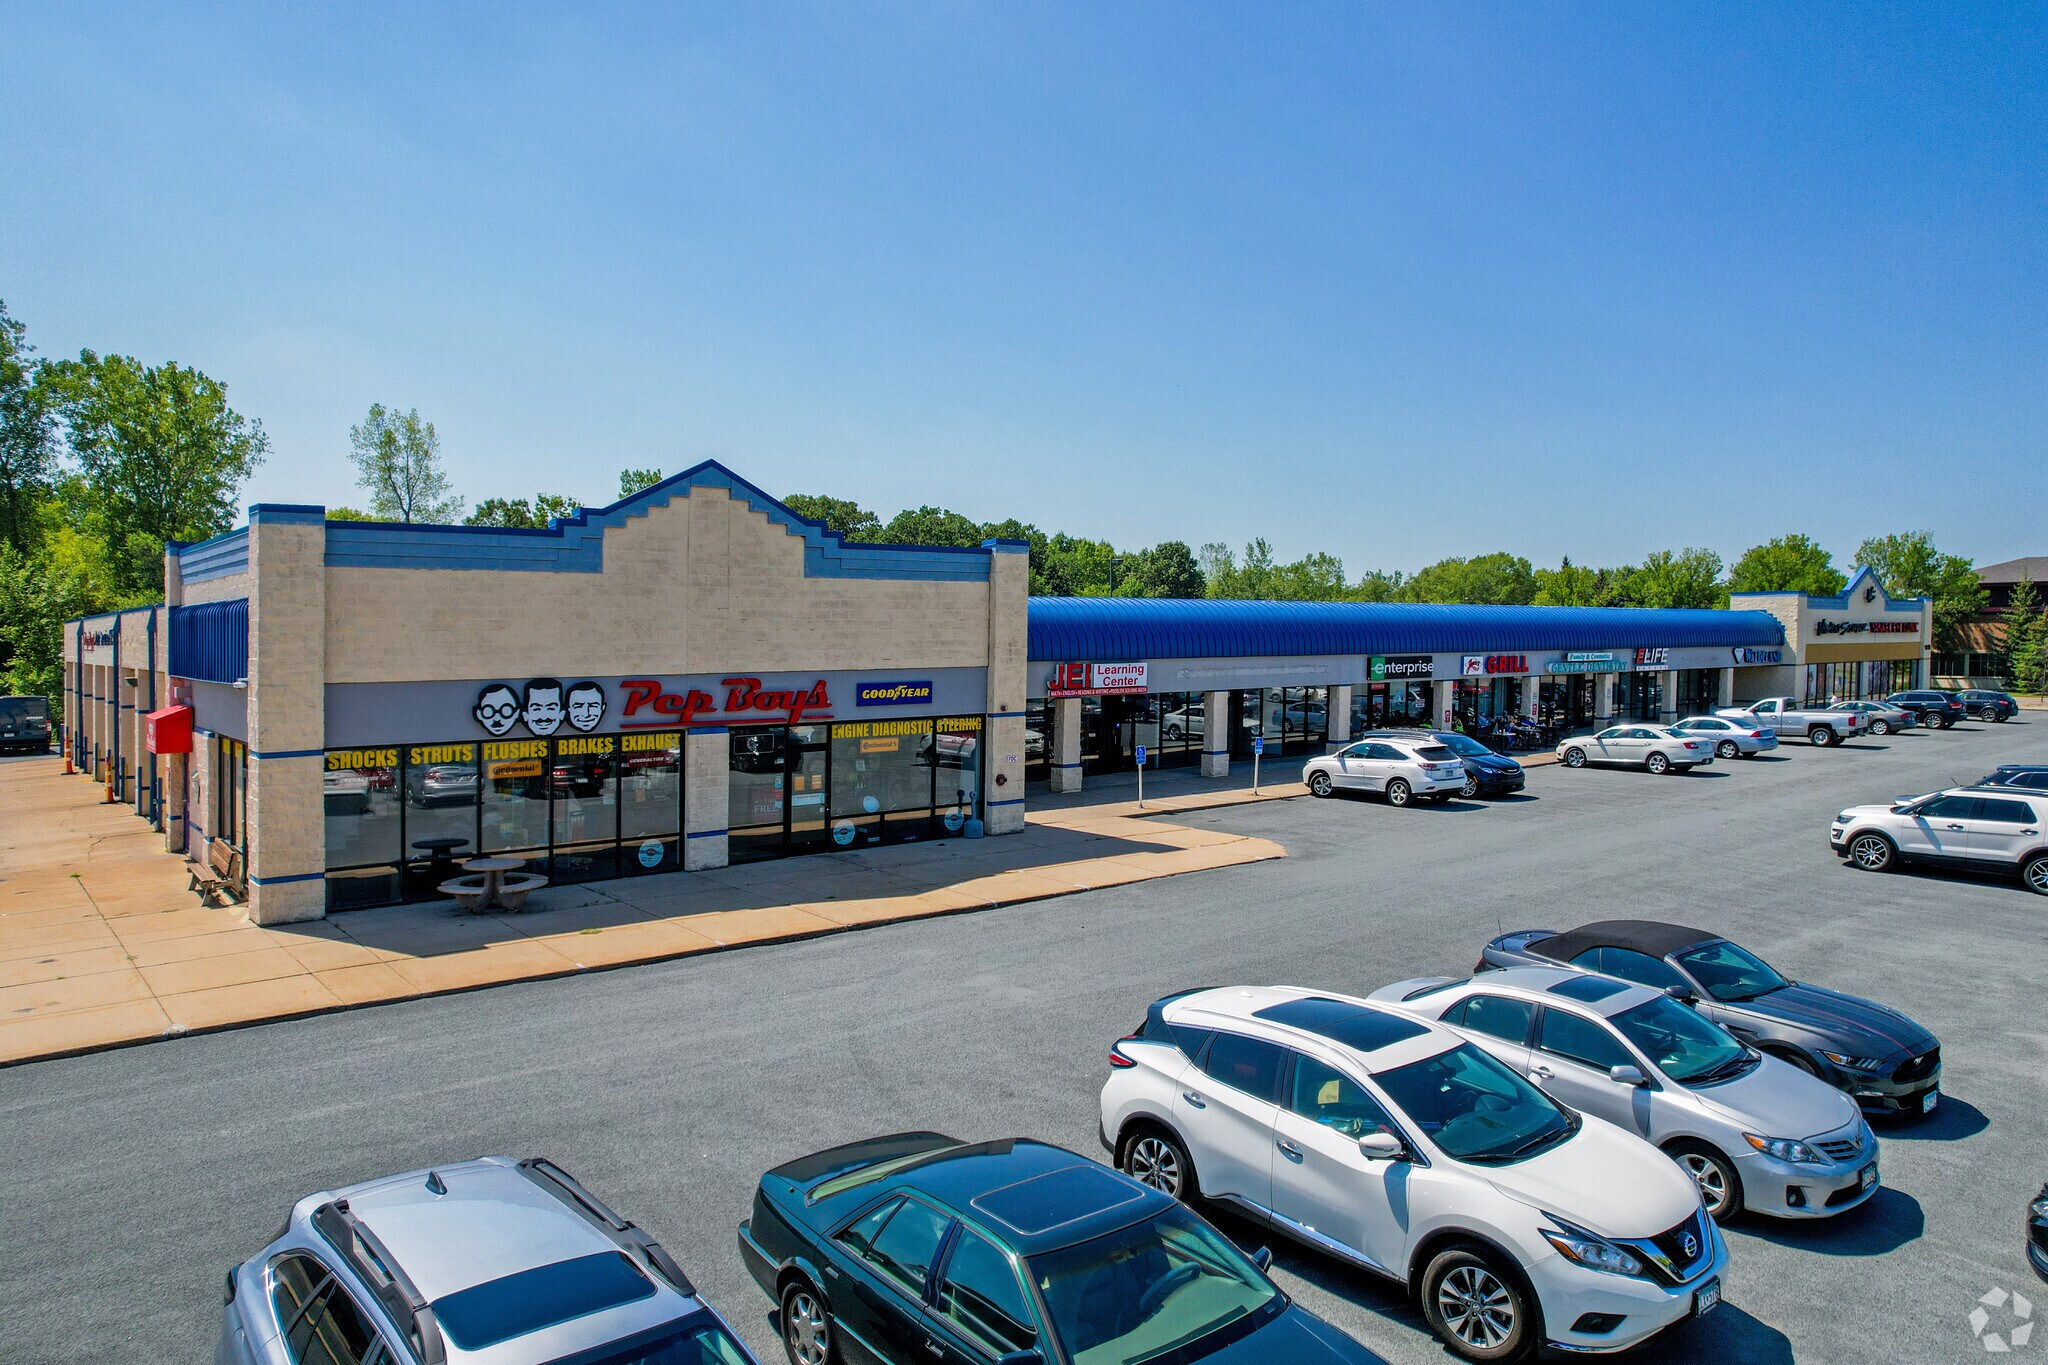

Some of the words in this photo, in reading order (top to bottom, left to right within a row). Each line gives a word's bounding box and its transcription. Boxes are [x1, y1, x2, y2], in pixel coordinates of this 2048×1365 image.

[1097, 664, 1144, 676] Learning
[1373, 660, 1434, 675] enterprise
[1487, 655, 1529, 674] GRILL
[1551, 662, 1584, 673] GENTLE
[1587, 661, 1628, 672] DENTISTRY
[1049, 663, 1091, 689] JEI
[1103, 676, 1138, 686] Center
[619, 680, 718, 723] Pep
[721, 677, 833, 725] Boys
[861, 686, 930, 700] GOODYEAR
[831, 723, 869, 739] ENGINE
[872, 719, 934, 737] DIAGNOSTIC
[936, 717, 982, 733] STEERING
[483, 740, 548, 760] FLUSHES
[558, 737, 614, 755] BRAKES
[621, 733, 681, 752] EXHAUST
[863, 741, 892, 751] Continental
[328, 749, 398, 770] SHOCKS
[410, 744, 473, 765] STRUTS
